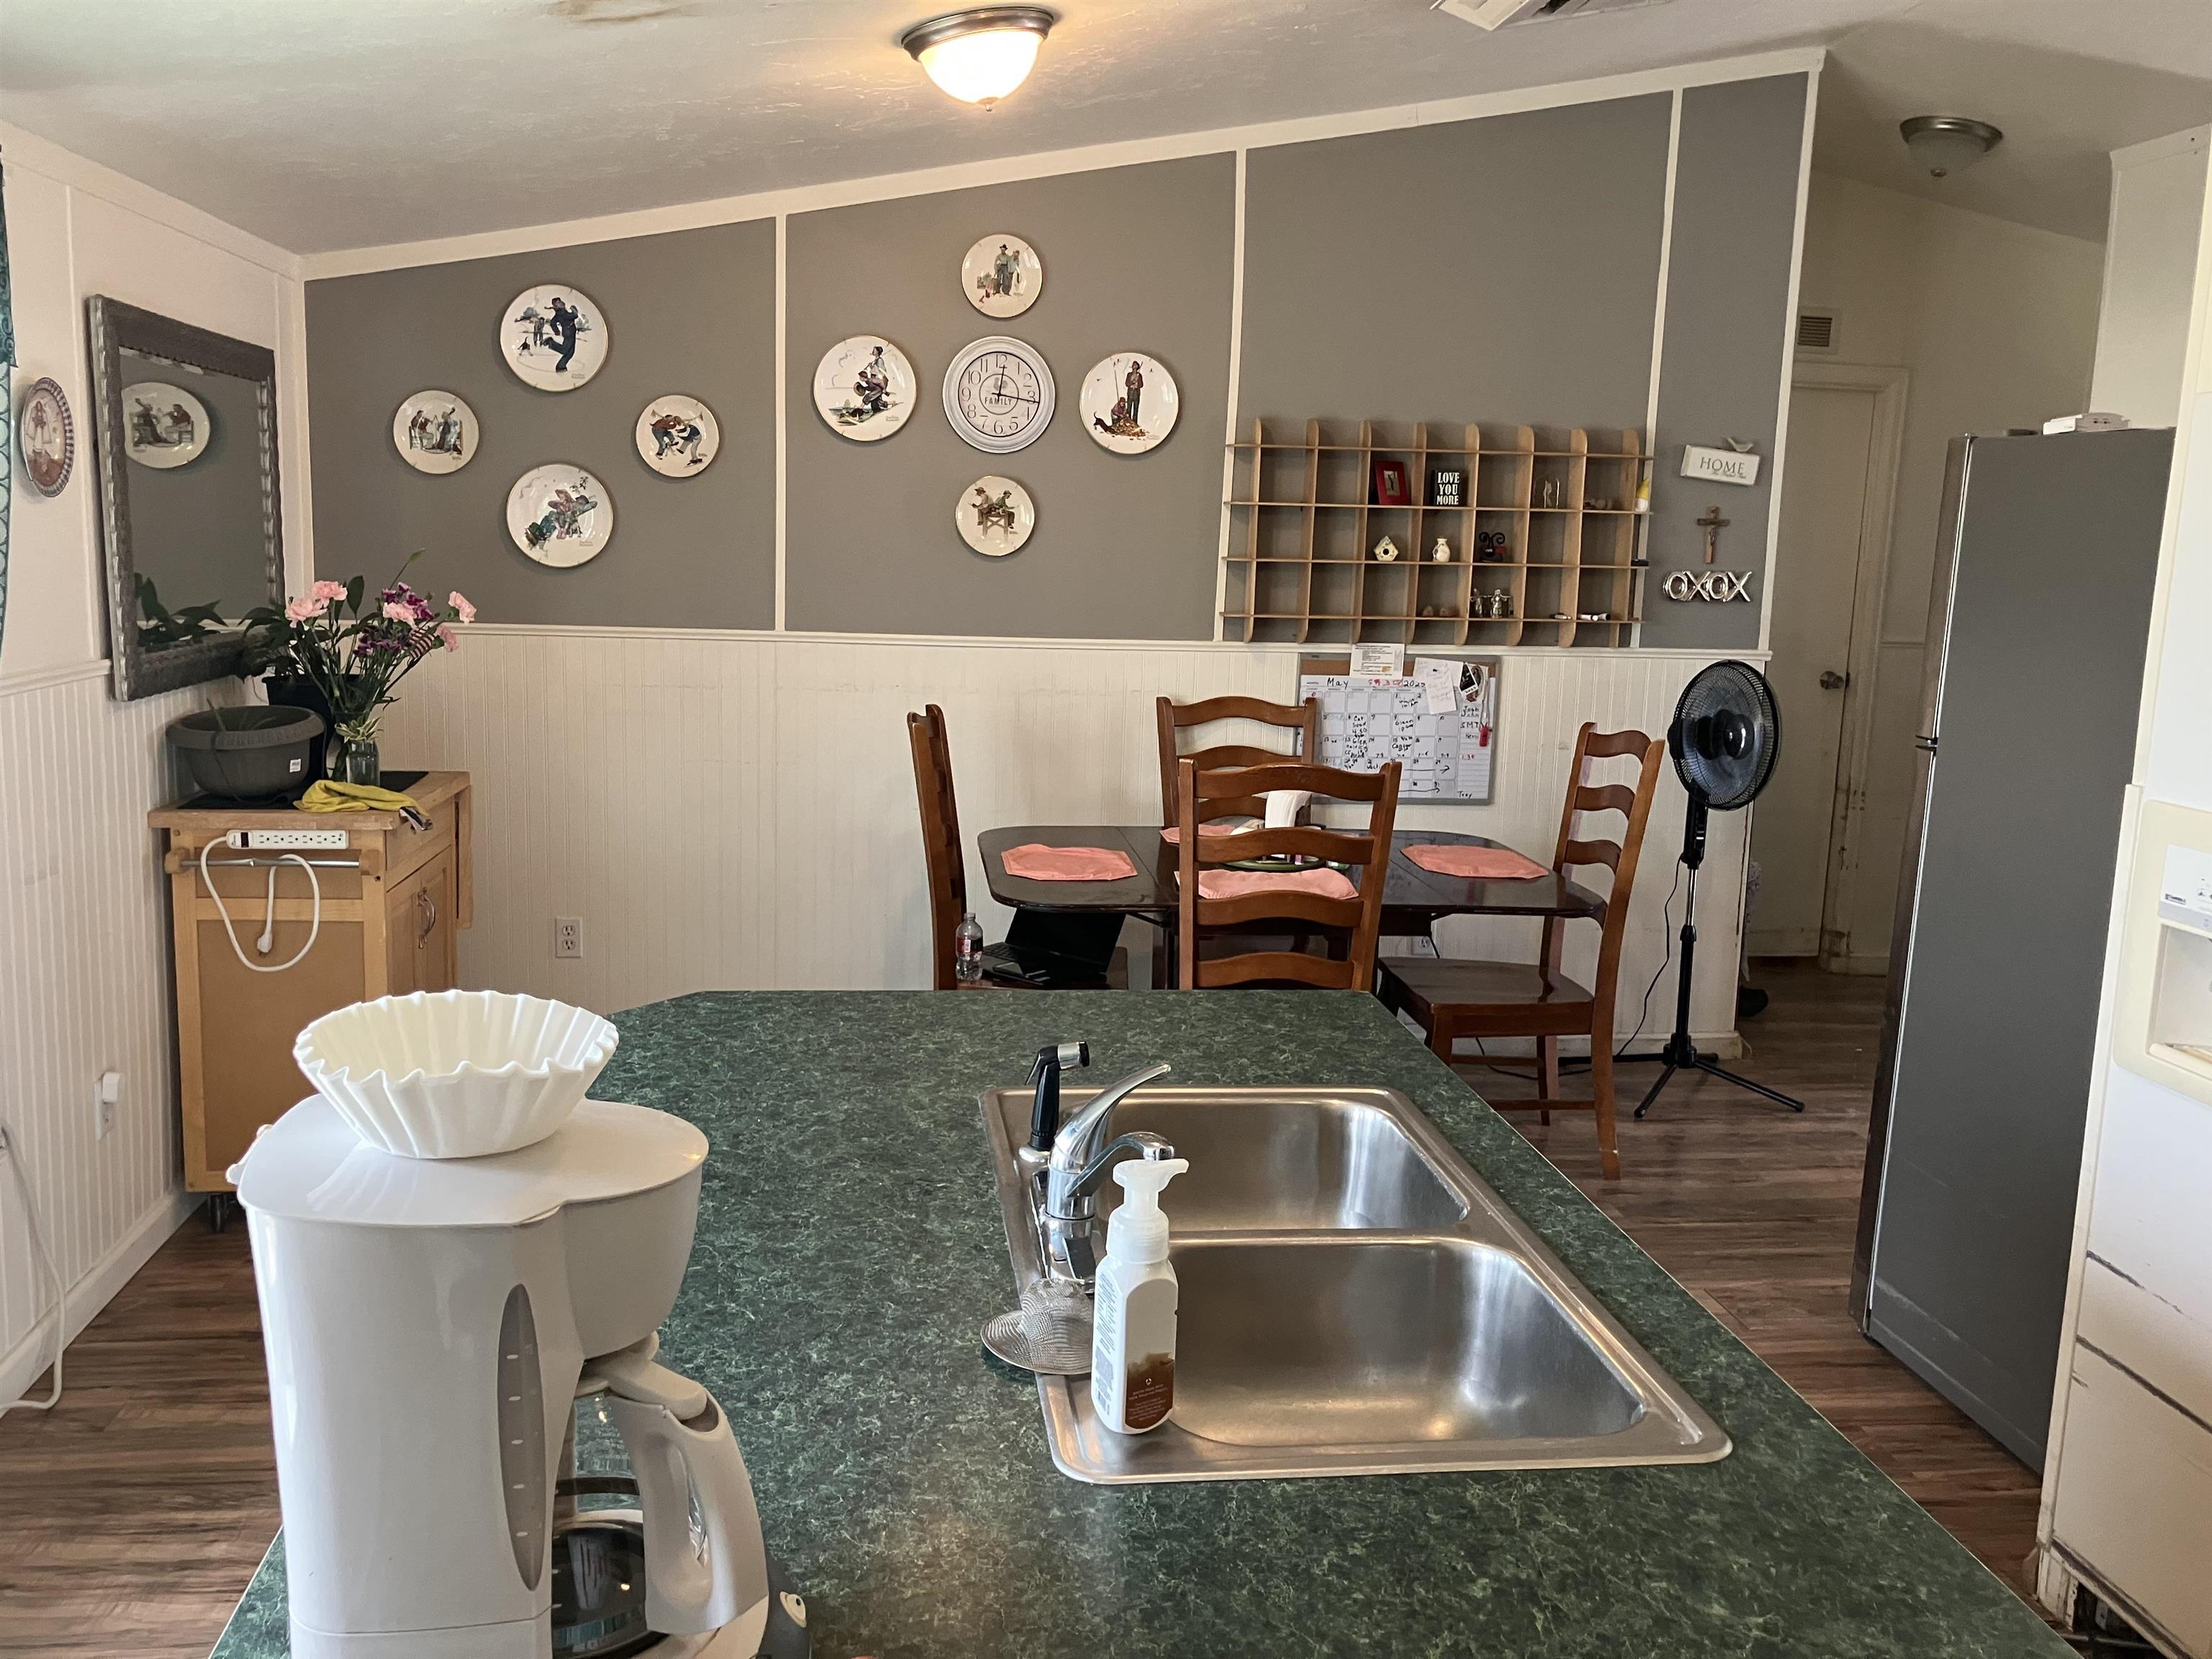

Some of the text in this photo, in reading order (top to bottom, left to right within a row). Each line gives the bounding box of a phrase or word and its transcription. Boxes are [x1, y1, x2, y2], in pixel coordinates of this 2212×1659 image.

[980, 358, 988, 372] 11
[996, 354, 1007, 369] 12
[1017, 361, 1020, 375] 1
[968, 370, 981, 385] 10
[1023, 372, 1032, 387] 2
[961, 387, 971, 402] 9
[984, 396, 1012, 405] FAMILY
[1027, 390, 1036, 405] 3
[967, 404, 976, 418] 8
[1021, 406, 1030, 421] 4
[980, 415, 988, 429] 7
[994, 420, 1003, 434] 6
[1009, 416, 1018, 431] 5
[1700, 457, 1745, 475] HOME
[1437, 472, 1460, 483] LOVE
[1439, 483, 1458, 495] YOU
[1437, 495, 1459, 505] MORE
[1326, 677, 1349, 690] May
